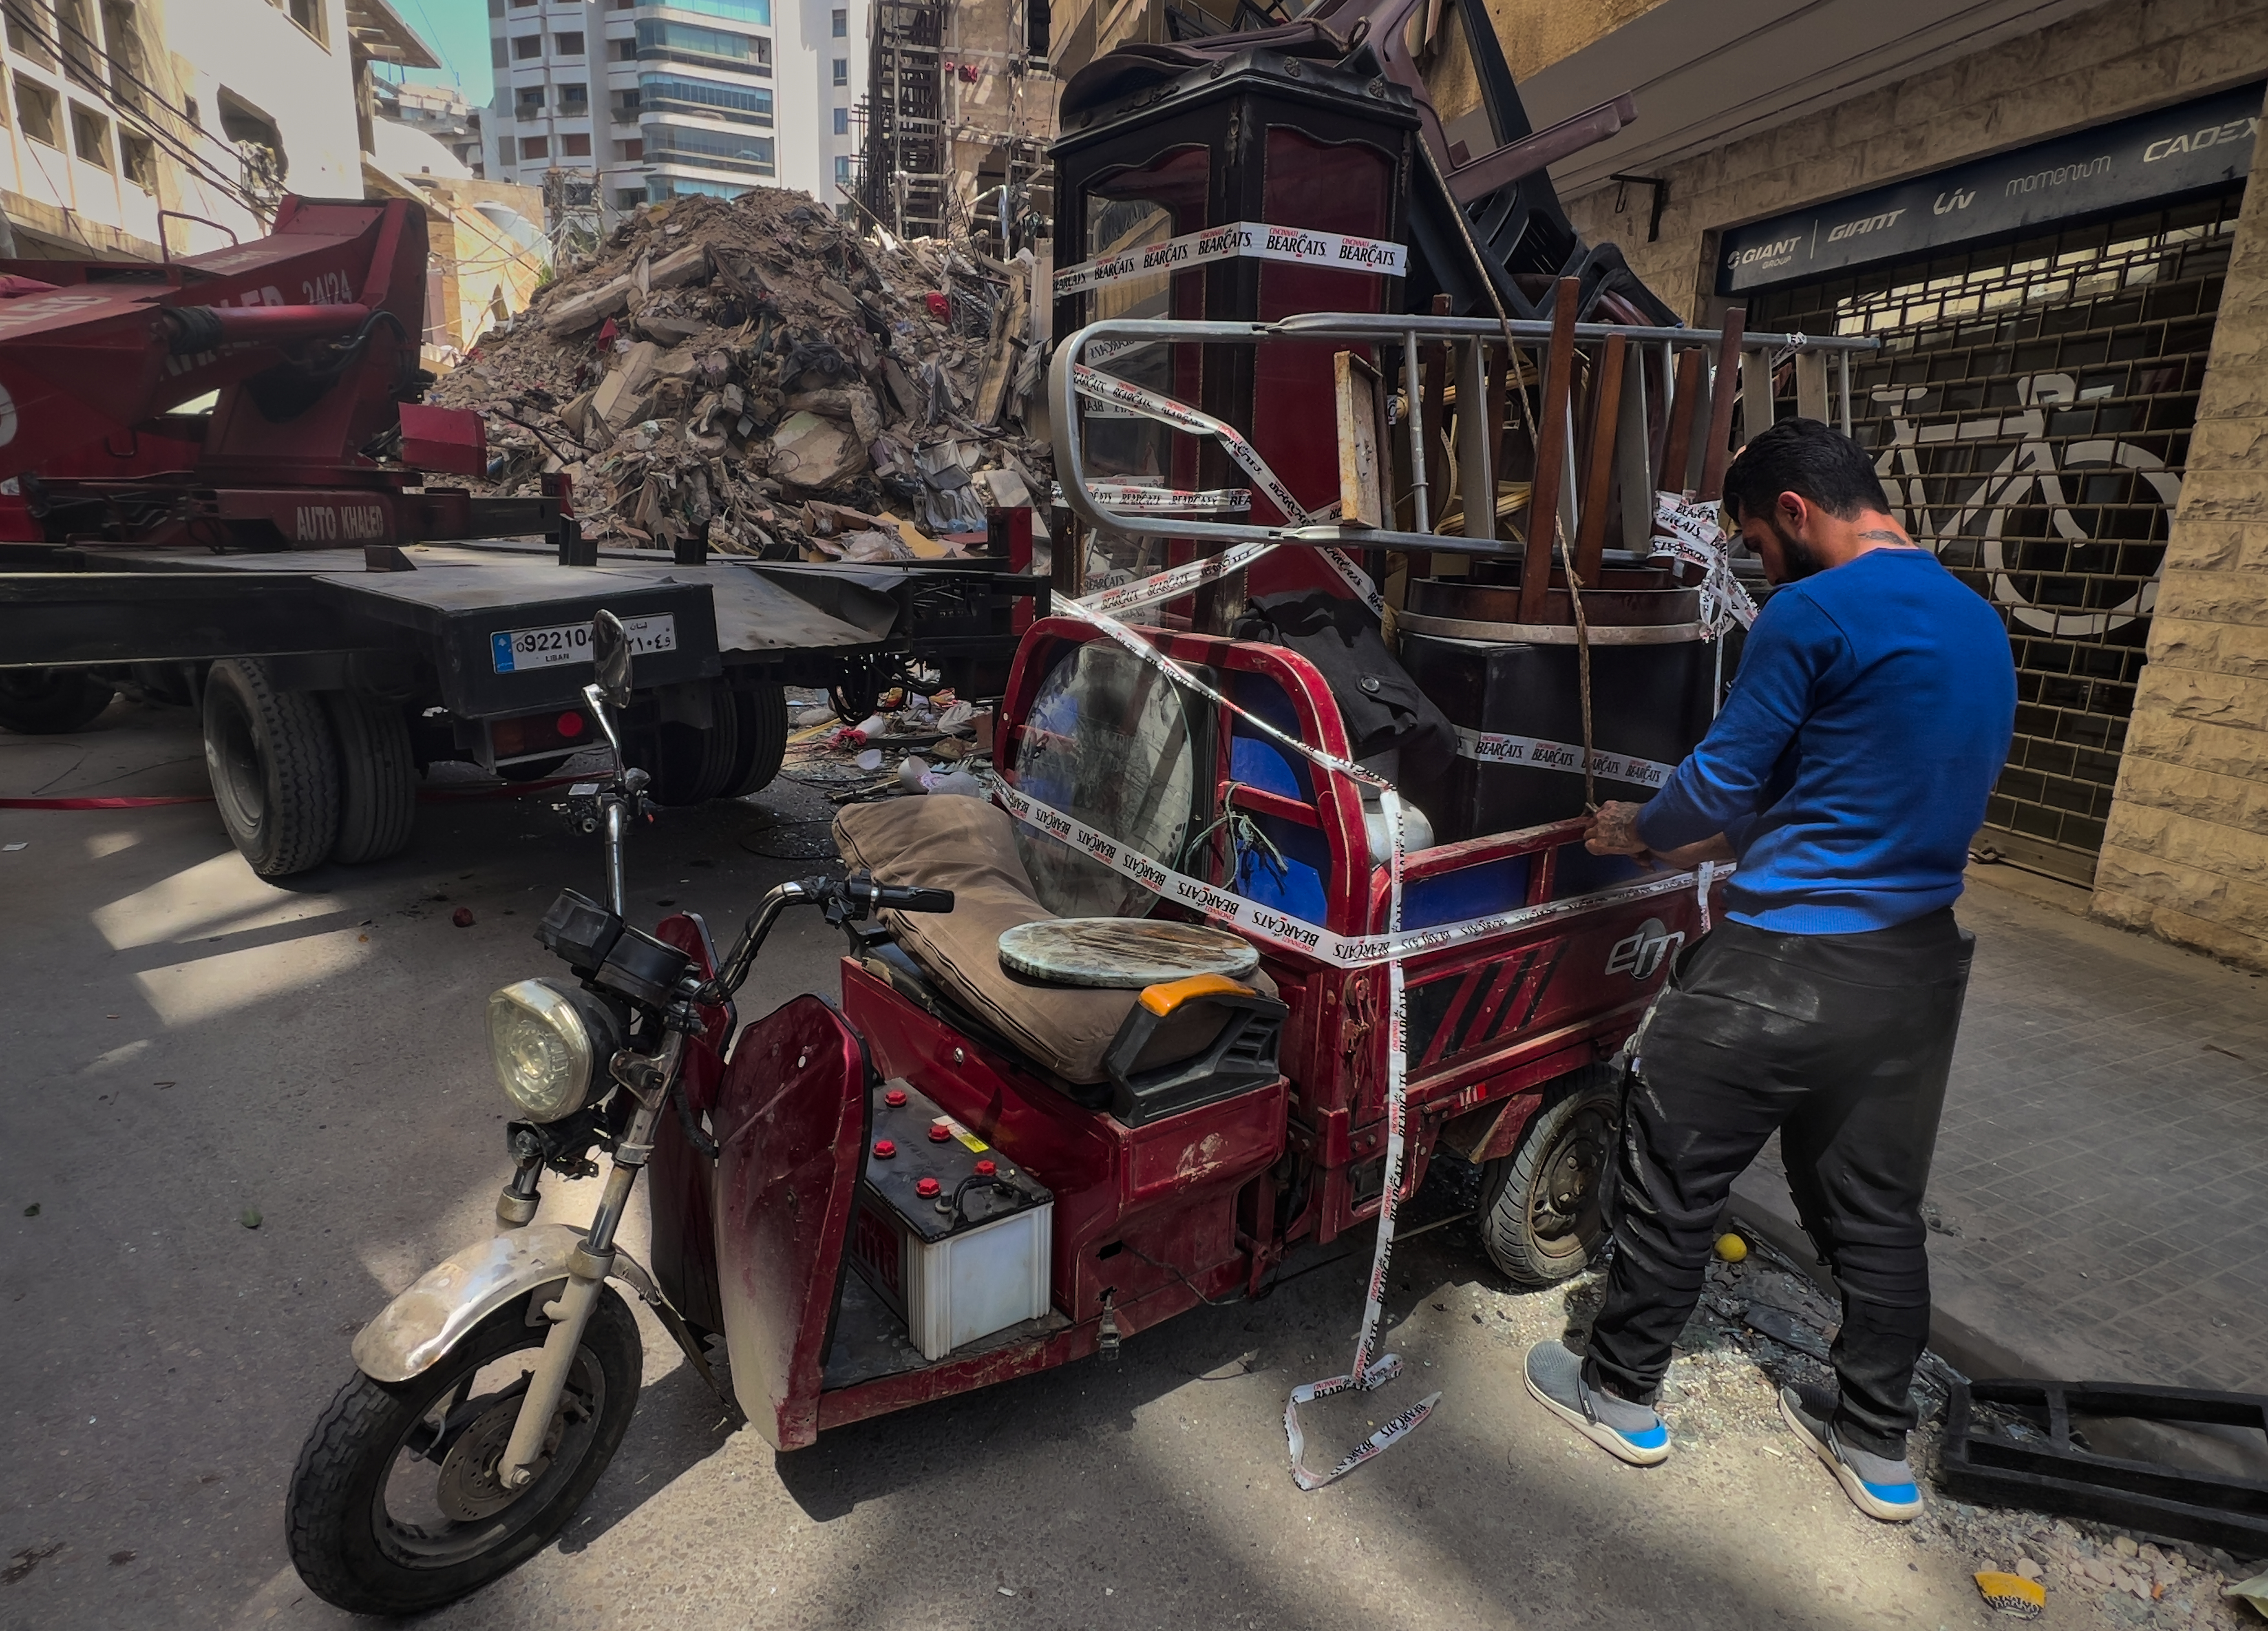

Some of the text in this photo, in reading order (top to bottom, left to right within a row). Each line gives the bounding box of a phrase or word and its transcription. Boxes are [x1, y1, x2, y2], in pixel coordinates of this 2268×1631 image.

[1828, 208, 1907, 242] GIANT
[2005, 156, 2111, 197] momentum
[2143, 117, 2261, 162] CADEX
[1095, 257, 1135, 280] BEARCATS
[1143, 243, 1188, 268] BEARCATS
[1198, 231, 1252, 255] BEARCATS
[1266, 235, 1327, 256] BEARCATS
[1339, 245, 1396, 266] BEARCATS
[1742, 236, 1802, 264] GIANT
[1762, 255, 1792, 269] GROUP
[297, 506, 384, 541] AUTO KHALED
[545, 653, 569, 663] LIBAN
[1474, 741, 1524, 758] BEARCATS
[1531, 747, 1574, 767] BEARCATS
[1581, 758, 1621, 774] BARCATS
[1625, 765, 1661, 782] BEARCATS
[1036, 809, 1072, 835] BEARCATS
[1077, 829, 1117, 859] BEARCATS
[1123, 854, 1167, 887] BEARCATS
[1177, 882, 1240, 916] BEARCATS
[1252, 911, 1320, 947] BEARCATS
